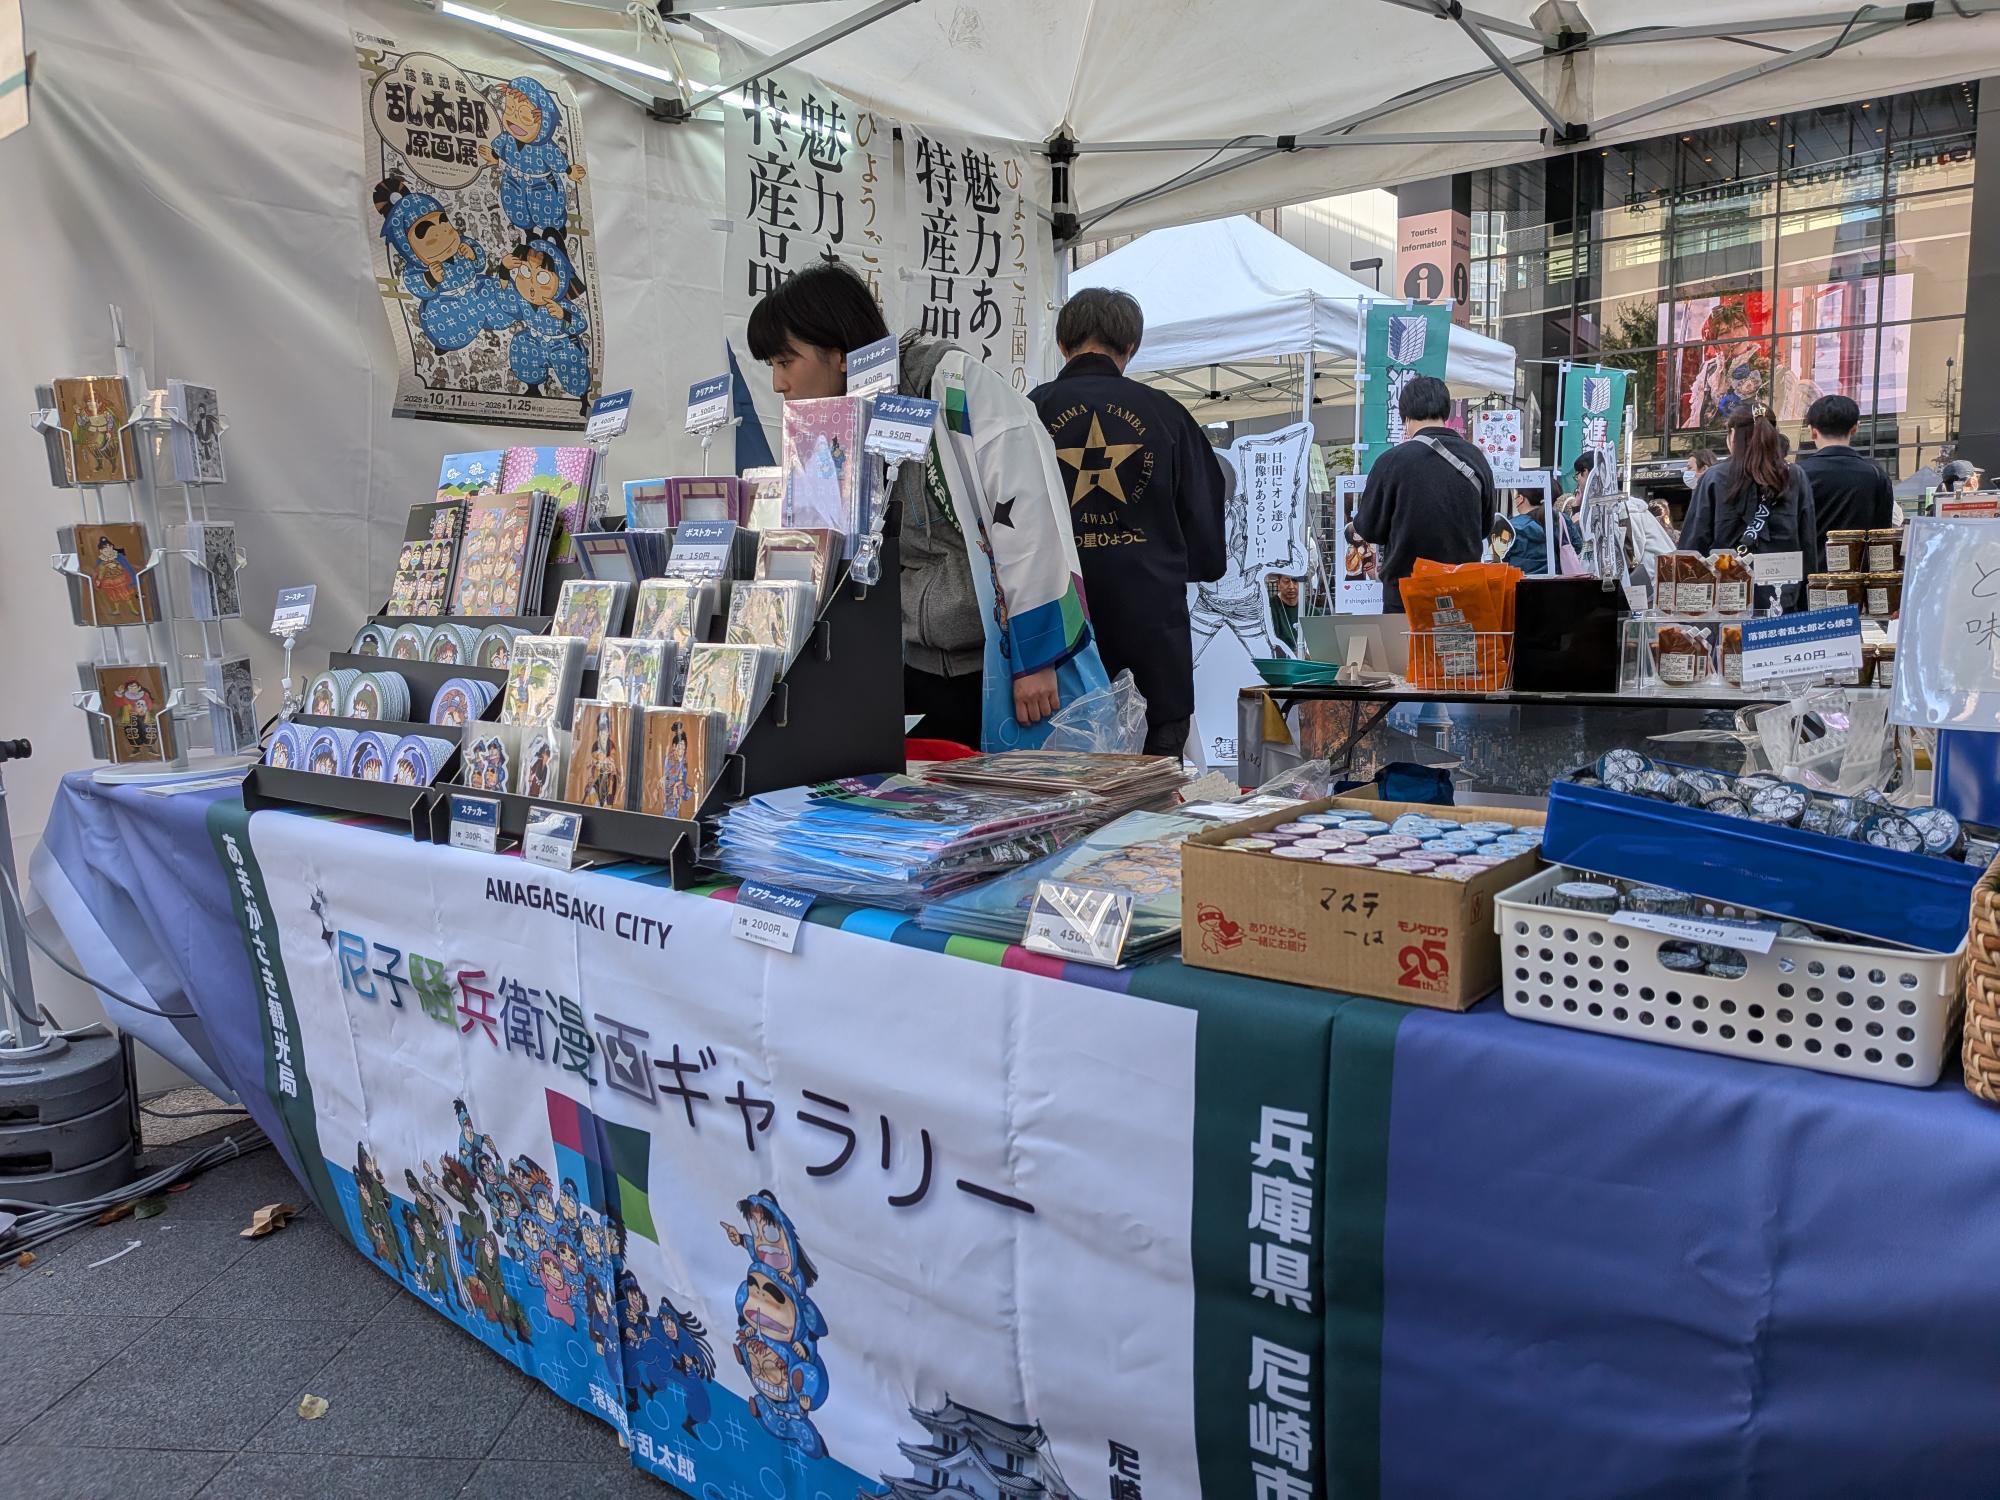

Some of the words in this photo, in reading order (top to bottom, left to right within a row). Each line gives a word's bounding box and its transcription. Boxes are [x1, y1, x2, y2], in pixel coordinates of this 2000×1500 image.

[385, 82, 490, 139] 乱太郎
[405, 127, 479, 168] 原画展
[742, 78, 802, 297] 特産品
[915, 135, 961, 339] 特産品
[1410, 227, 1438, 238] Tourist
[960, 147, 1002, 364] 魅力あ
[1401, 239, 1447, 253] Information
[1003, 157, 1028, 393] ひょうご五国の
[852, 345, 891, 368] チケットホルダー
[879, 401, 932, 418] タオルハンカチ
[1105, 403, 1147, 436] TAMBA
[888, 429, 911, 441] 950円
[1271, 452, 1284, 533] 日田にオレ達の
[1254, 451, 1266, 559] 銅像があるらしい!!
[1079, 511, 1120, 525] AWAJI
[684, 527, 725, 538] ポストカード
[689, 551, 710, 560] 150円
[284, 592, 305, 601] コースター
[1747, 617, 1854, 642] 落第忍者乱太郎どら焼き
[1784, 649, 1826, 664] 540円
[461, 805, 488, 817] ステッカー
[464, 831, 482, 842] 300円
[541, 843, 559, 856] 200円
[747, 886, 804, 908] マフラータオル
[1320, 887, 1380, 919] マステ
[485, 877, 606, 932] AMAGASAKI
[614, 910, 674, 950] CITY
[751, 918, 782, 936] 2000円
[1060, 928, 1087, 945] 450
[1249, 922, 1308, 943] ありがとうと
[1397, 920, 1449, 939] モノタロウ
[1667, 922, 1725, 938] 500円
[1249, 936, 1308, 954] 一緒にお届け
[221, 831, 298, 1099] あまがさき観光局
[1247, 1104, 1315, 1314] 兵庫県
[1247, 1335, 1313, 1500] 尼崎市
[588, 1382, 698, 1484] 落第忍乱太郎
